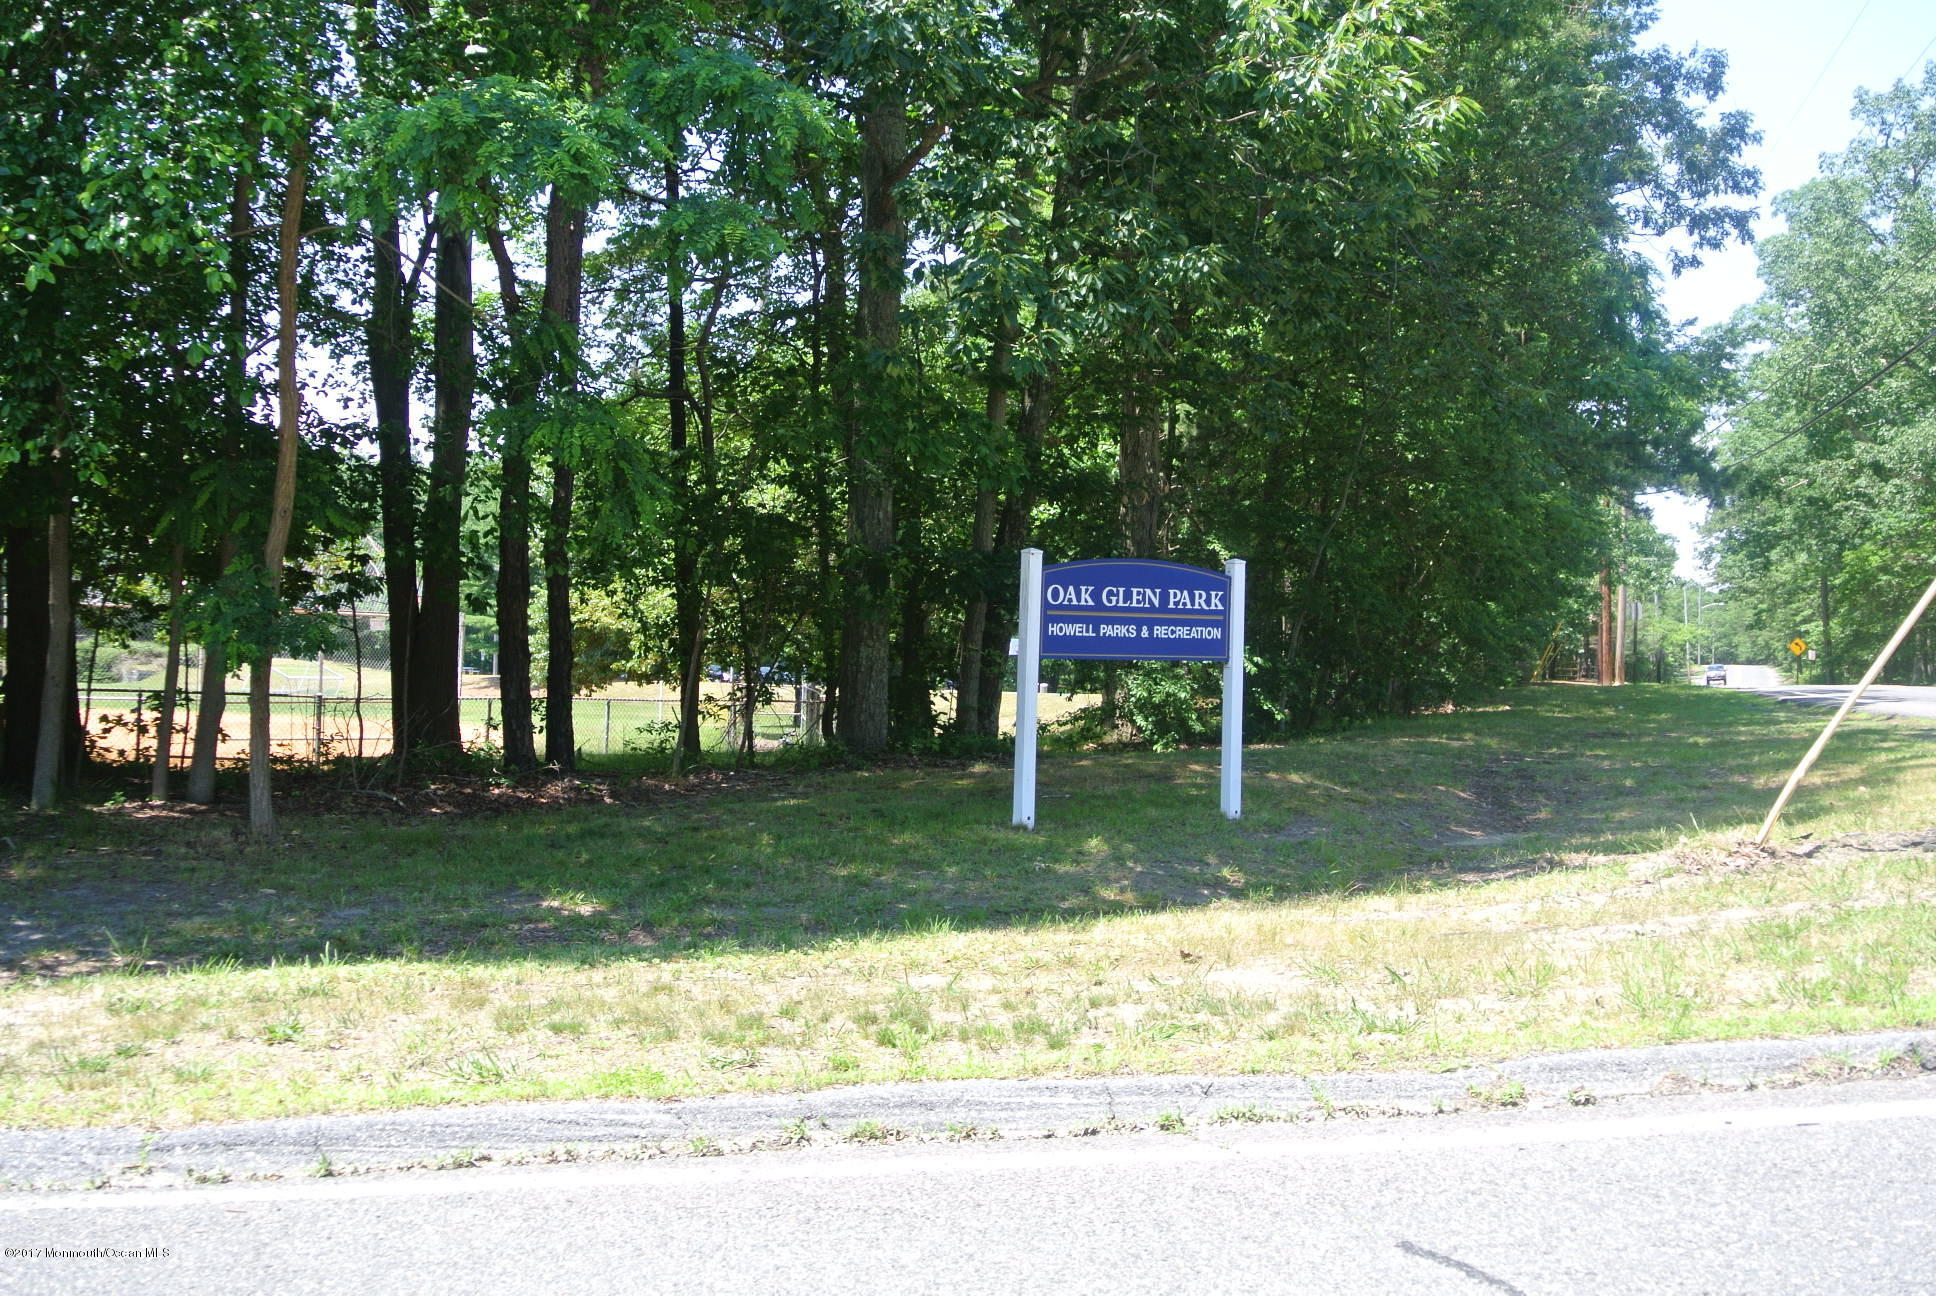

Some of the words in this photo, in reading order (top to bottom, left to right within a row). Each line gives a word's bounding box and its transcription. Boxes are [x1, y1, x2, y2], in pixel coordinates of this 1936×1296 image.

[1046, 584, 1096, 606] OAK
[1101, 586, 1162, 608] GLEN
[1167, 589, 1225, 610] PARK
[1048, 622, 1096, 637] HOWELL
[1099, 624, 1137, 638] PARKS
[1140, 626, 1149, 638] &
[1153, 626, 1222, 640] RECREATION
